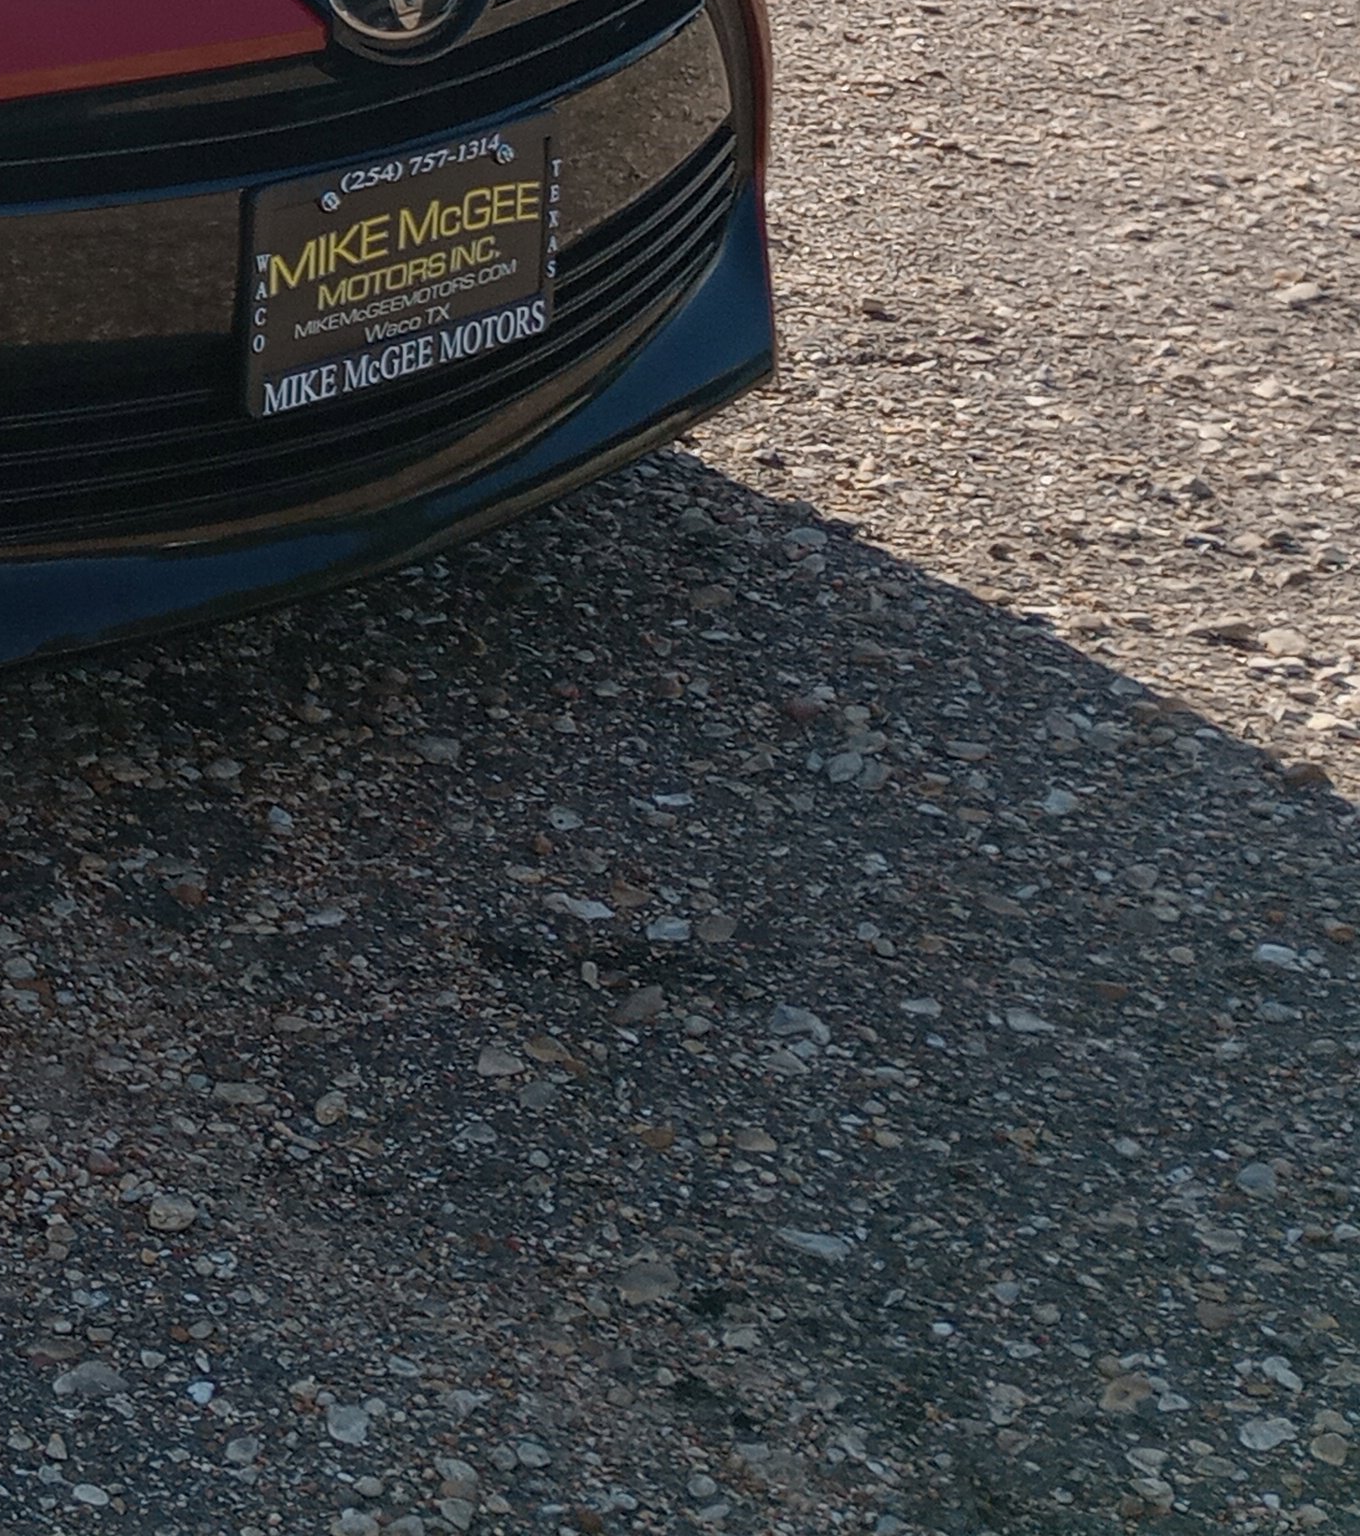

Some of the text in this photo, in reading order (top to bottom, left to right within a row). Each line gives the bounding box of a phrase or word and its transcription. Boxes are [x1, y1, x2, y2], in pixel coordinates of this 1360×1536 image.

[340, 133, 501, 194] (254) 757-1314
[269, 180, 541, 297] MIKE McGEE
[544, 158, 563, 279] TEXAS
[252, 253, 272, 354] WACO
[293, 258, 518, 340] MIKEMcGEEMOTORS.COM
[317, 235, 502, 311] MOTORS INC.
[262, 299, 546, 416] MIKE McGEE MOTORS
[364, 302, 451, 344] Waco TX
